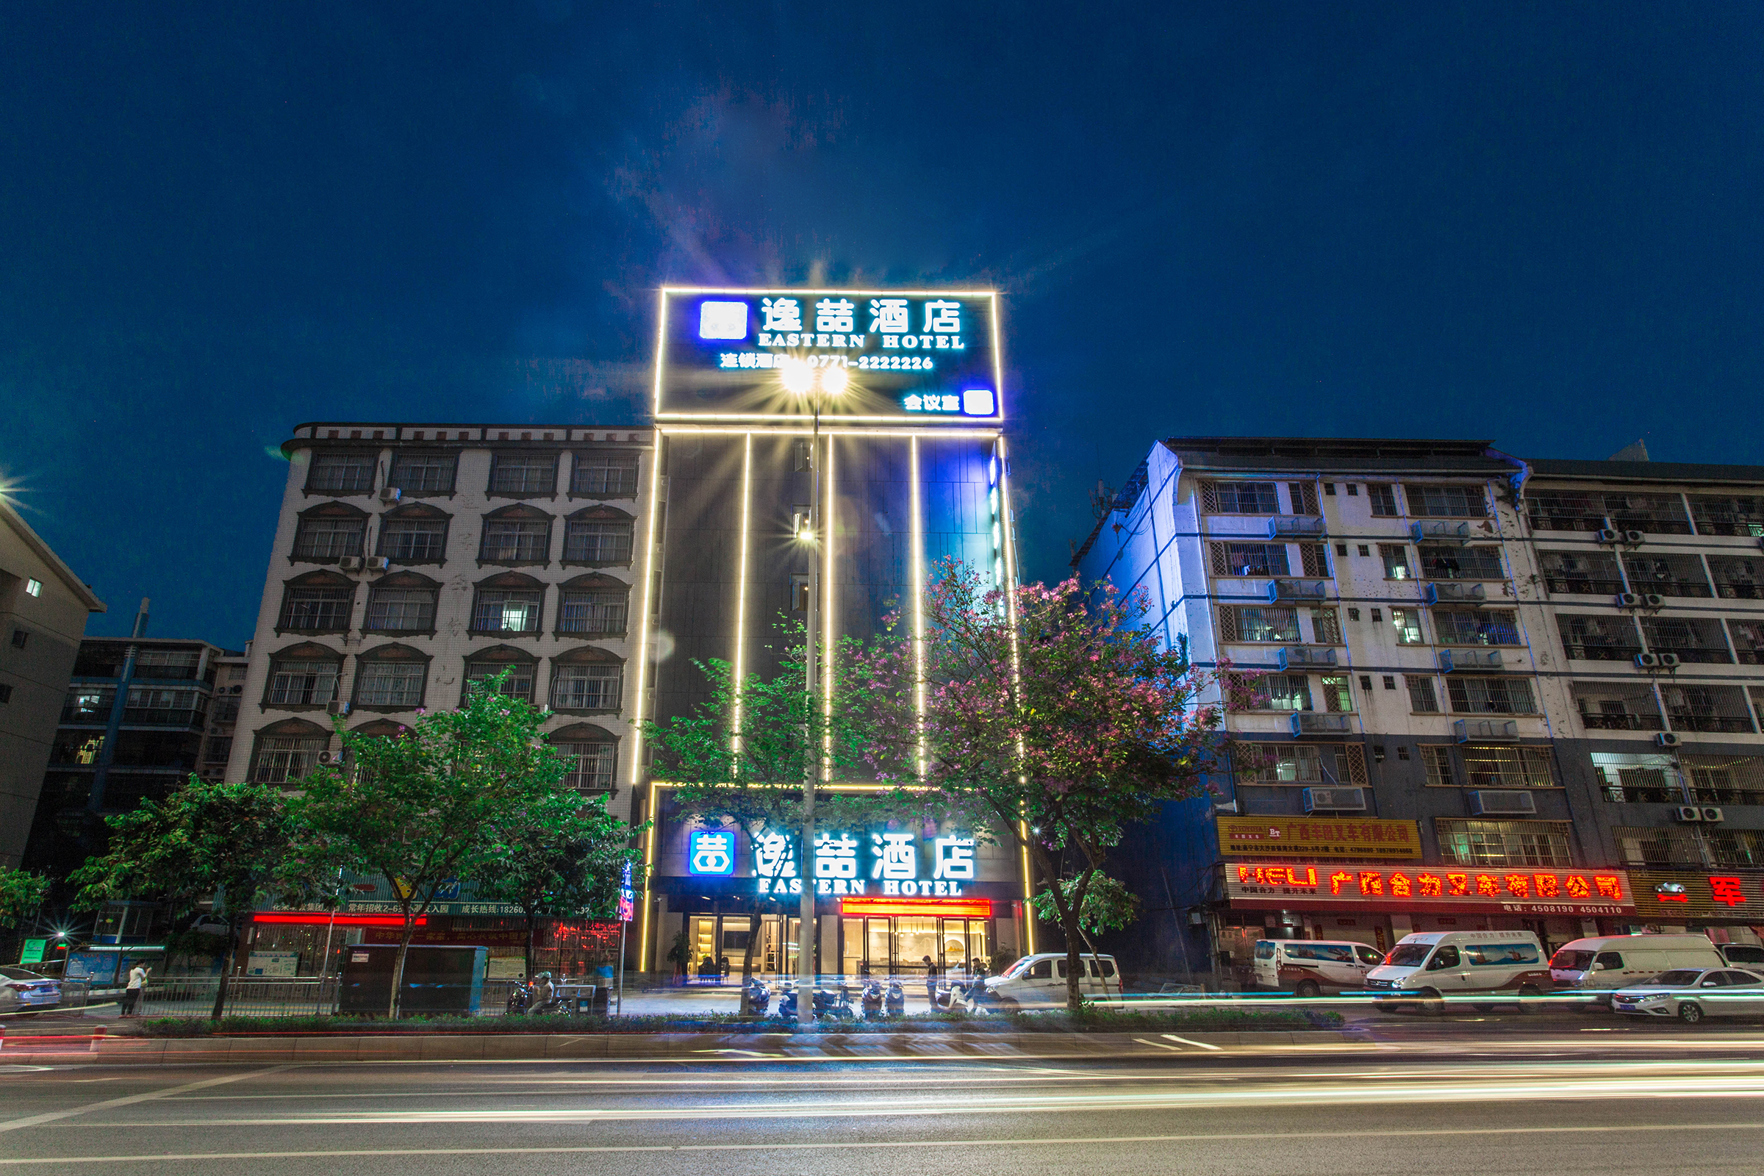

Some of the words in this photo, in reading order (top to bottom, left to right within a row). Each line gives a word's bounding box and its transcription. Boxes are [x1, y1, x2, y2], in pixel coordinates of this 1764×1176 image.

[761, 298, 961, 333] 逸喆酒店
[758, 333, 866, 349] EASTERN
[882, 335, 965, 350] HOTEL
[758, 878, 866, 894] EASERN
[883, 880, 963, 896] HOTEL
[1331, 871, 1622, 899] 广西合力叉车有限公司
[1531, 905, 1574, 913] 4508190
[1580, 906, 1622, 914] 4504110
